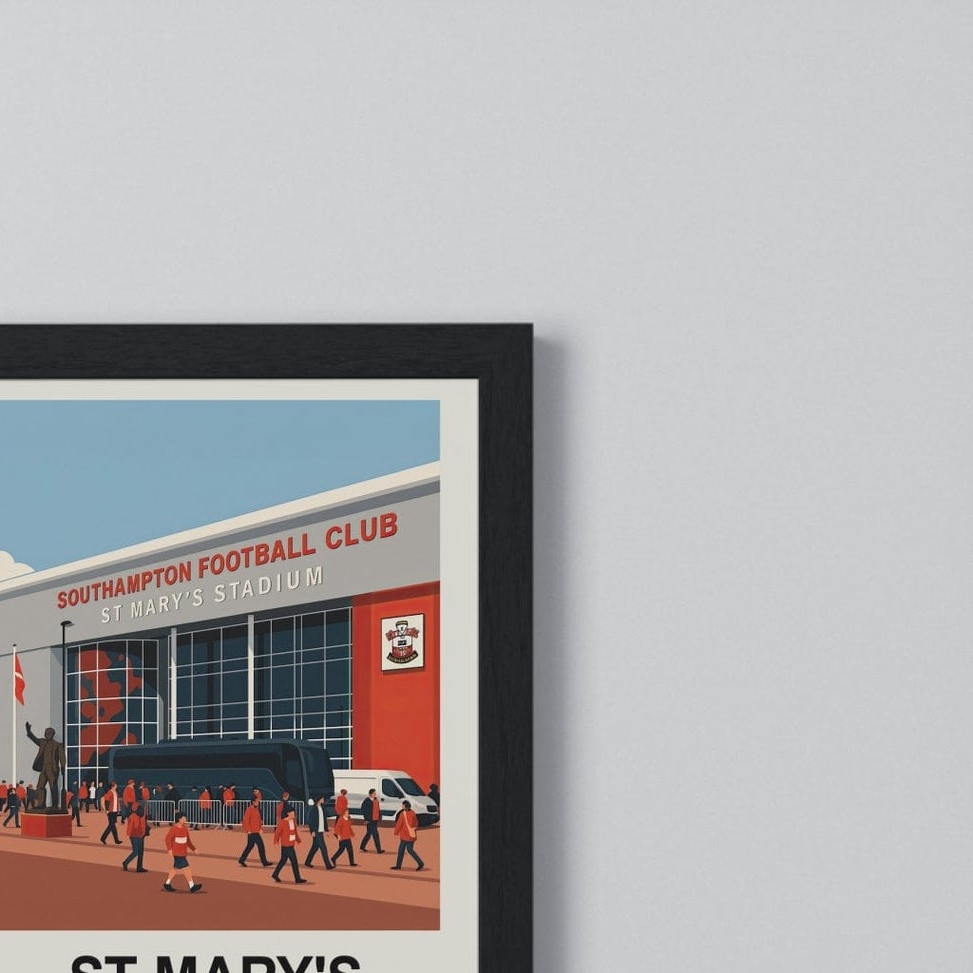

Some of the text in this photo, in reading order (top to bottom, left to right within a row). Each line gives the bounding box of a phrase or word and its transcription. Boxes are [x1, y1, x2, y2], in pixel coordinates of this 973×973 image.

[57, 512, 398, 609] SOUTHAMPTON FOOTBALL CLUB
[101, 565, 323, 623] ST MARY'S STADIUM
